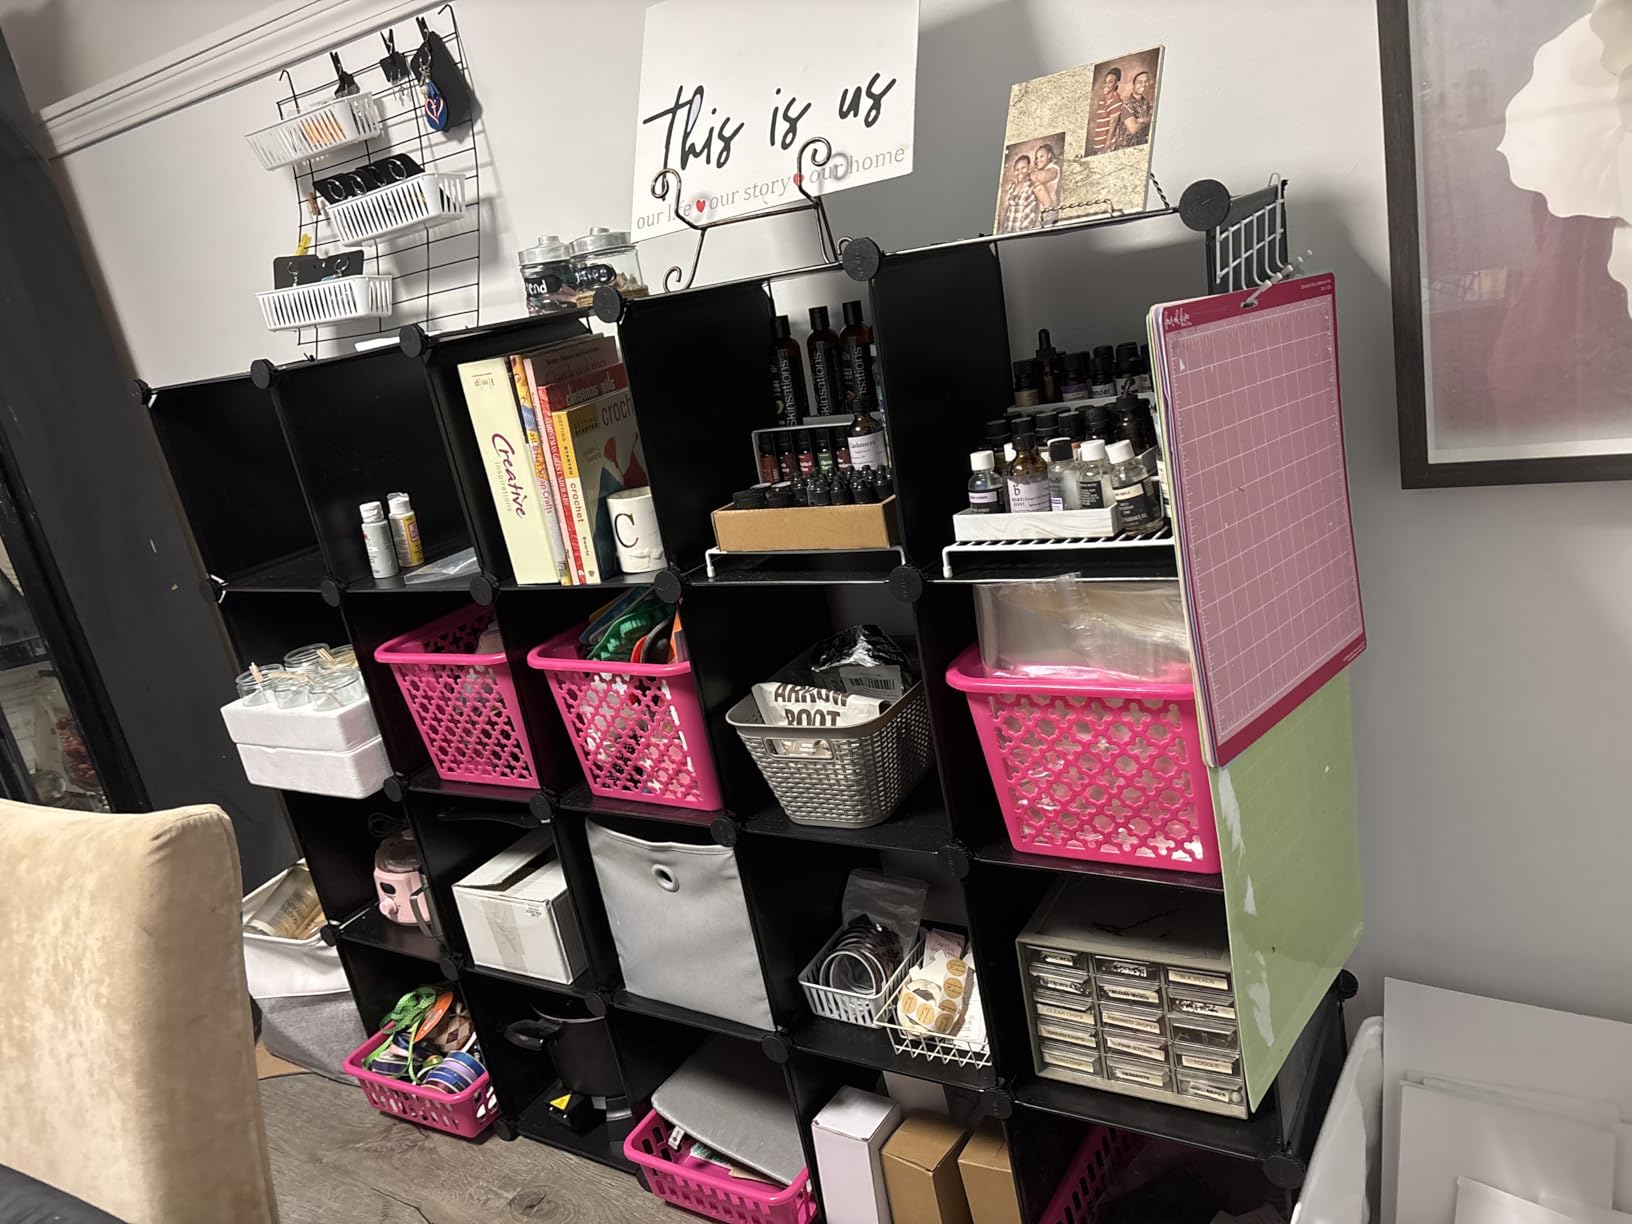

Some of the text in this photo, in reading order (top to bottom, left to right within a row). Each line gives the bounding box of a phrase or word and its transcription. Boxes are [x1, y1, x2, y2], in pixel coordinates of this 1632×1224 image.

[770, 88, 811, 150] is
[838, 73, 896, 128] us
[637, 147, 905, 229] our lfe our story our home
[491, 433, 526, 518] Creative
[495, 462, 513, 512] inspirations
[535, 467, 549, 490] Scrap
[541, 489, 555, 514] Crafts
[569, 482, 585, 523] crochet
[613, 512, 640, 549] C
